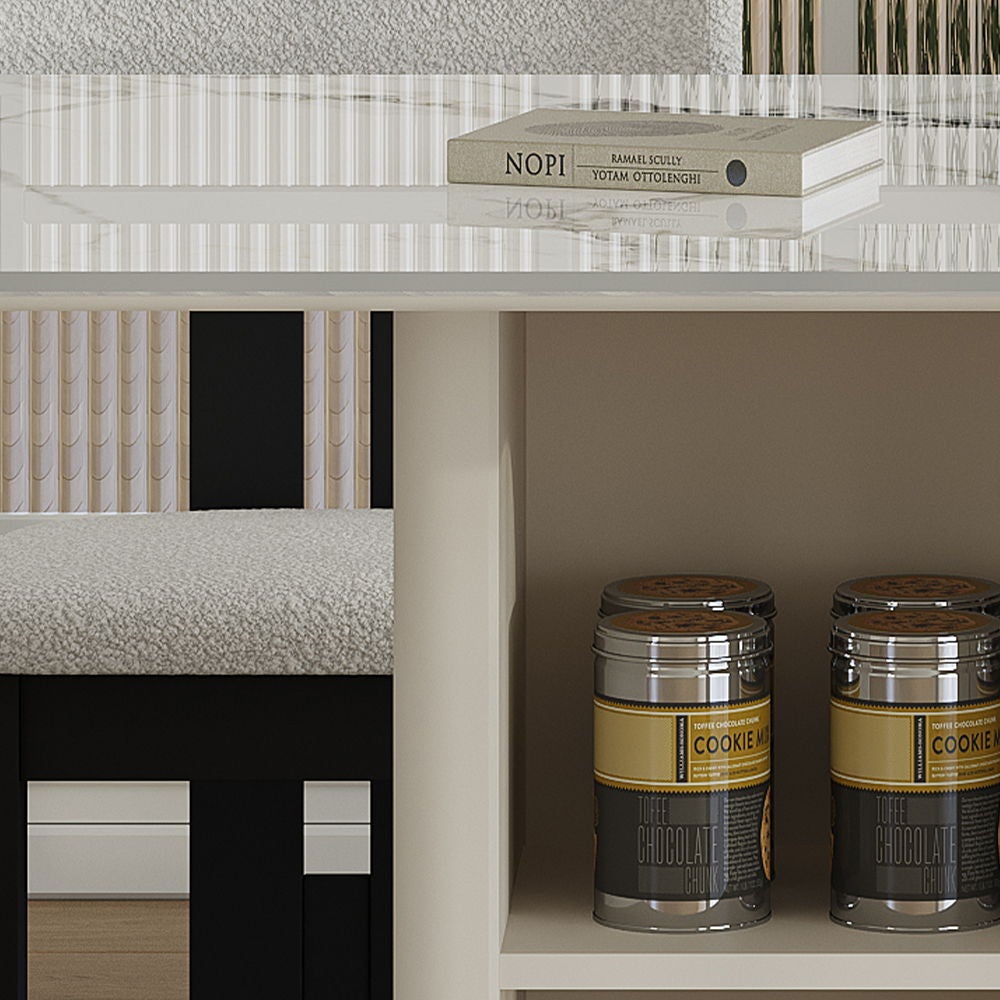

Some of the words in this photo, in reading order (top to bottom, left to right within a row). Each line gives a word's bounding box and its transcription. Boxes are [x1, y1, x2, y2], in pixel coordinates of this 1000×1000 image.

[505, 152, 566, 176] NOPI
[611, 153, 647, 165] RAMAEL
[649, 155, 683, 167] SCULLY
[592, 169, 630, 182] YOTAM
[632, 170, 702, 185] OTTOLENGHI
[715, 718, 745, 729] CHOCOLATE
[953, 719, 983, 729] CHOCOLATE
[693, 730, 754, 755] COOKIE
[931, 730, 991, 755] COOKIE
[638, 825, 719, 865] CHOCOLATE
[875, 825, 957, 865] CHOCOLATE
[685, 866, 720, 895] CHUNK
